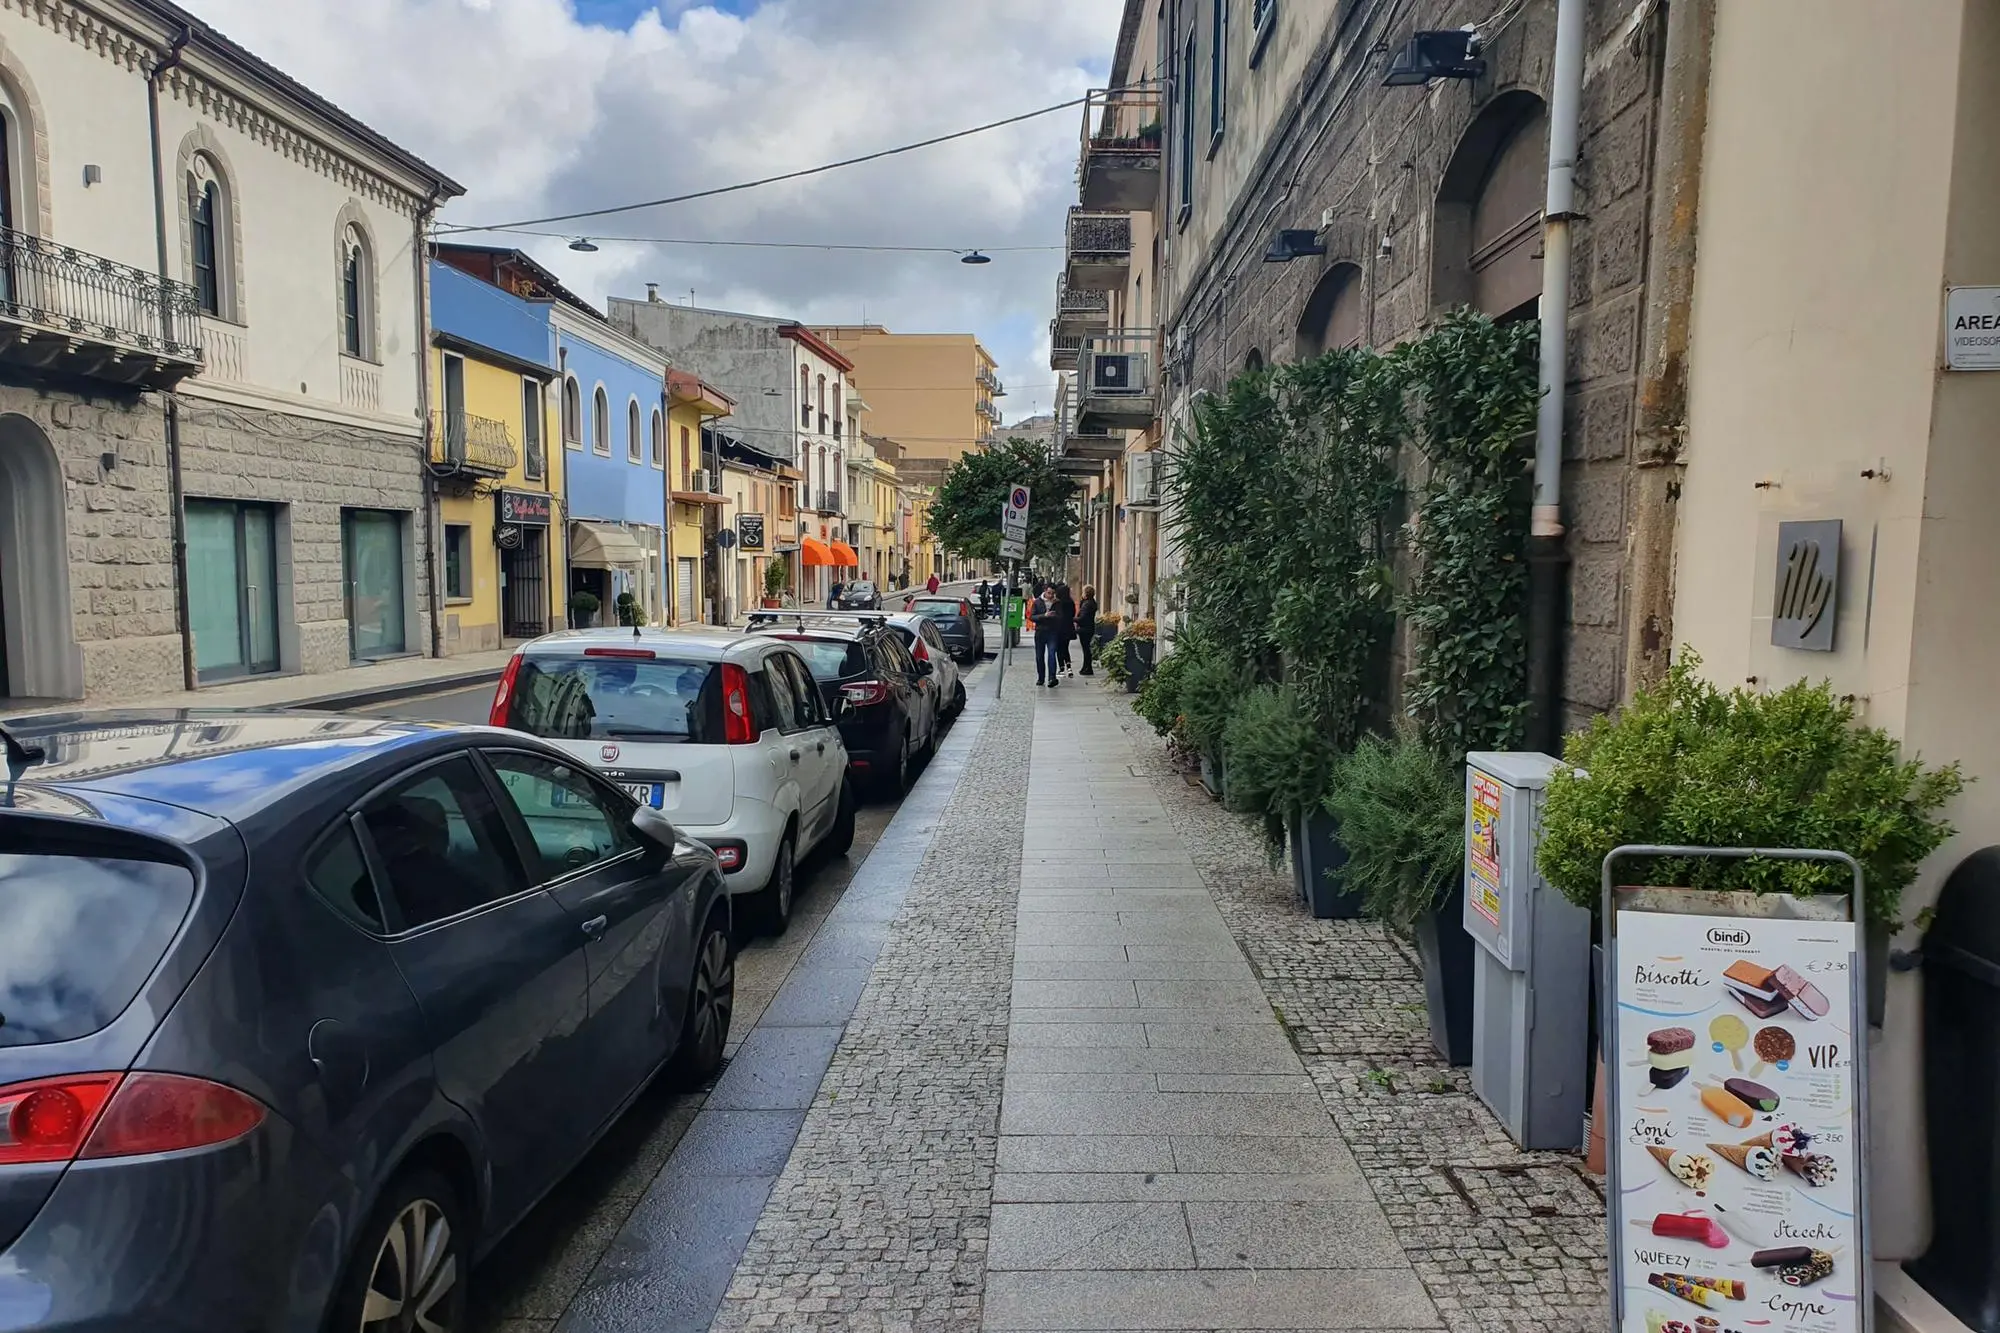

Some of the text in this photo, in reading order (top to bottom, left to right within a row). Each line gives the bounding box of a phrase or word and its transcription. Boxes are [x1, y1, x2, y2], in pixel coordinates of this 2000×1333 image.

[1955, 315, 2000, 330] AREA
[1778, 539, 1832, 639] illy
[1714, 930, 1744, 943] bindi
[1635, 963, 1710, 986] Biscotti
[1808, 1044, 1838, 1069] VIP
[1631, 1118, 1678, 1138] Coni
[1774, 1219, 1841, 1239] Stecchi
[1634, 1249, 1691, 1270] SQUEEZY
[1761, 1294, 1835, 1322] Coppe
